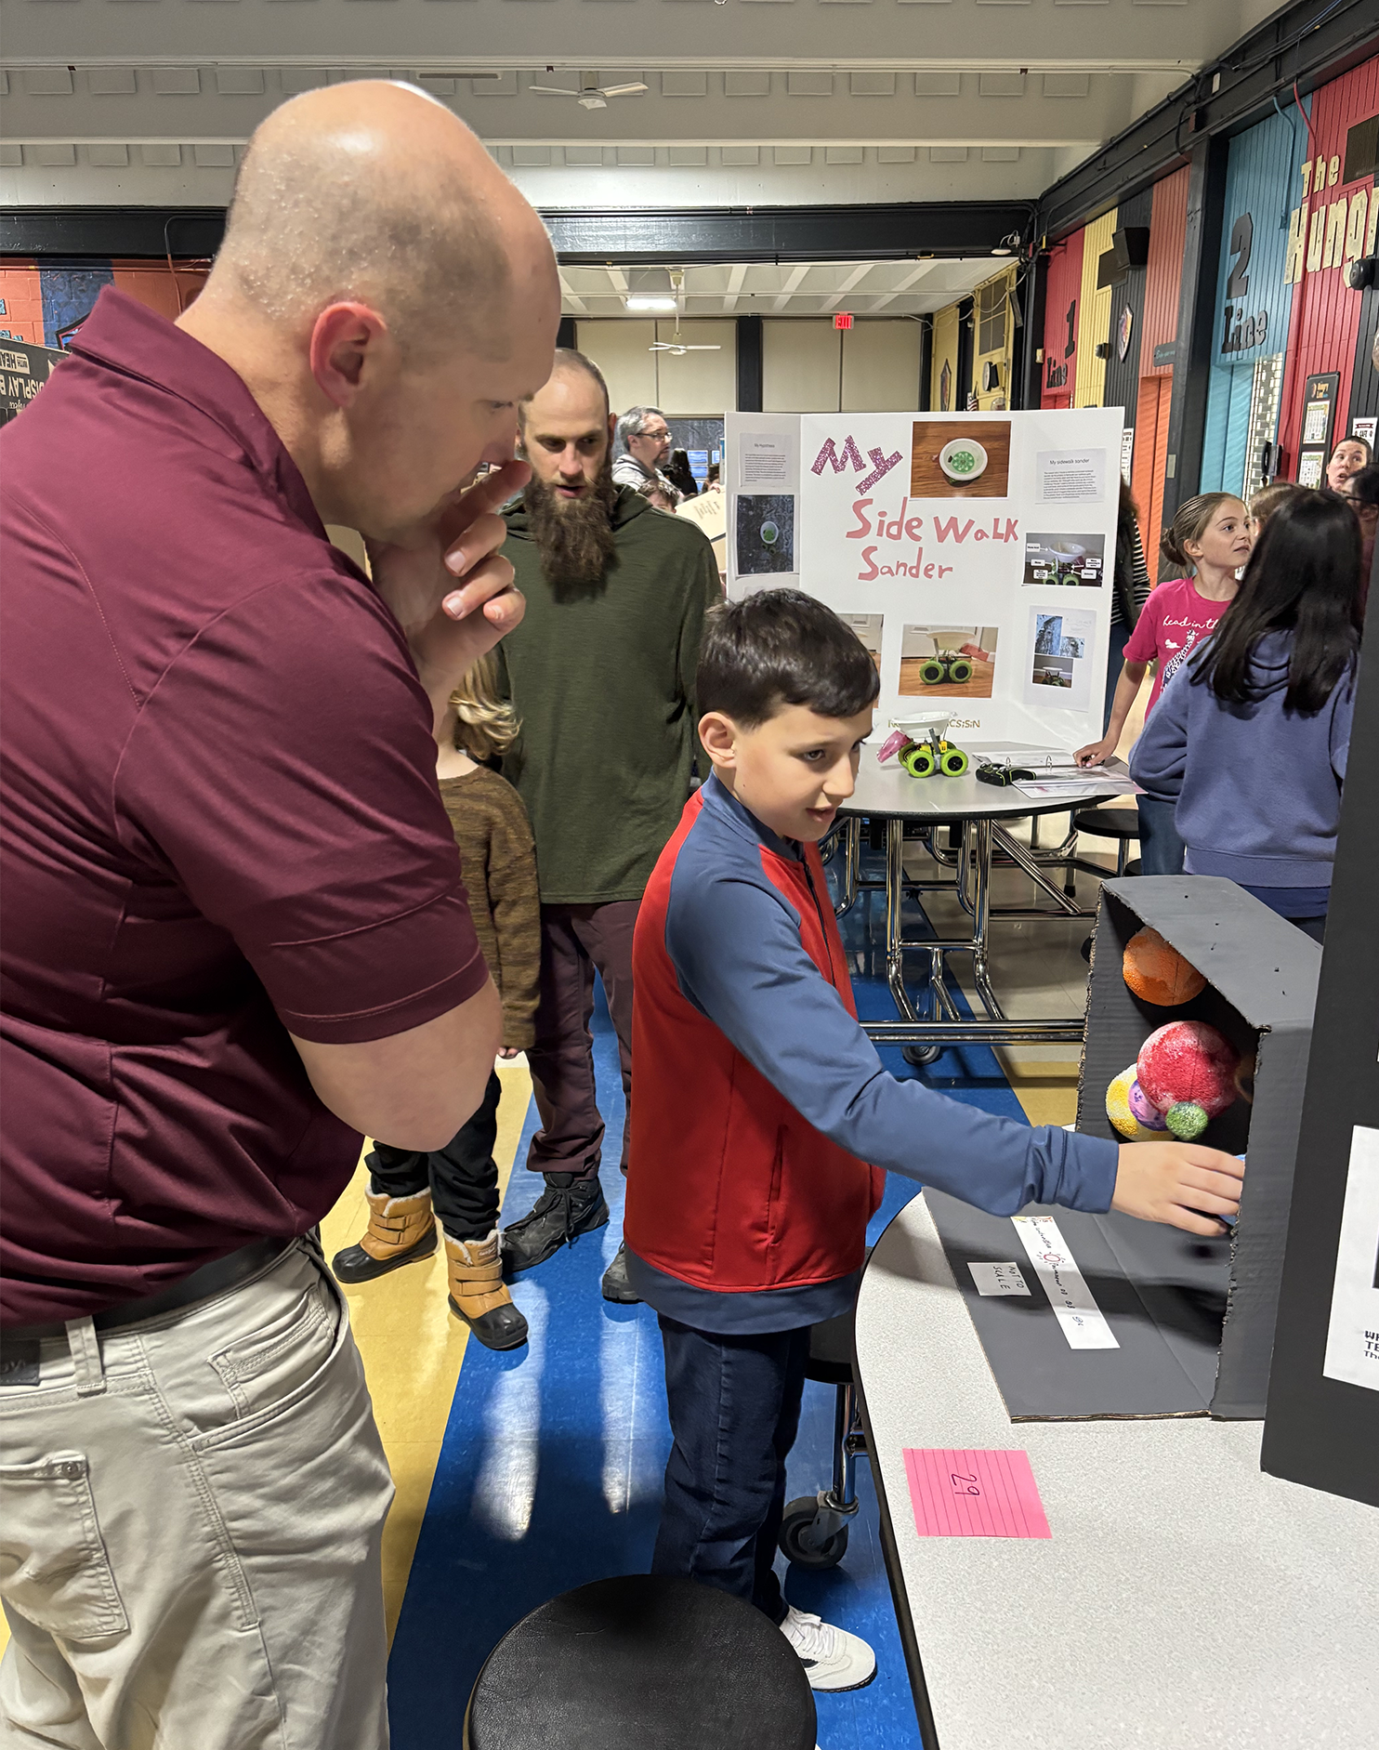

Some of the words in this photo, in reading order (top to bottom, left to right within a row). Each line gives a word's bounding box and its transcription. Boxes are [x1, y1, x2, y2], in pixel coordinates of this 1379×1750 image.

[1301, 154, 1341, 199] The
[1226, 212, 1253, 299] 2
[1065, 300, 1076, 359] 1
[1221, 305, 1268, 354] Line
[1046, 357, 1068, 388] Line
[810, 434, 904, 496] My
[845, 496, 924, 542] Side
[857, 545, 953, 582] Sander
[1163, 615, 1190, 626] head
[992, 1265, 1011, 1290] SCALE
[1015, 1280, 1025, 1289] TO
[951, 1473, 980, 1496] 29
